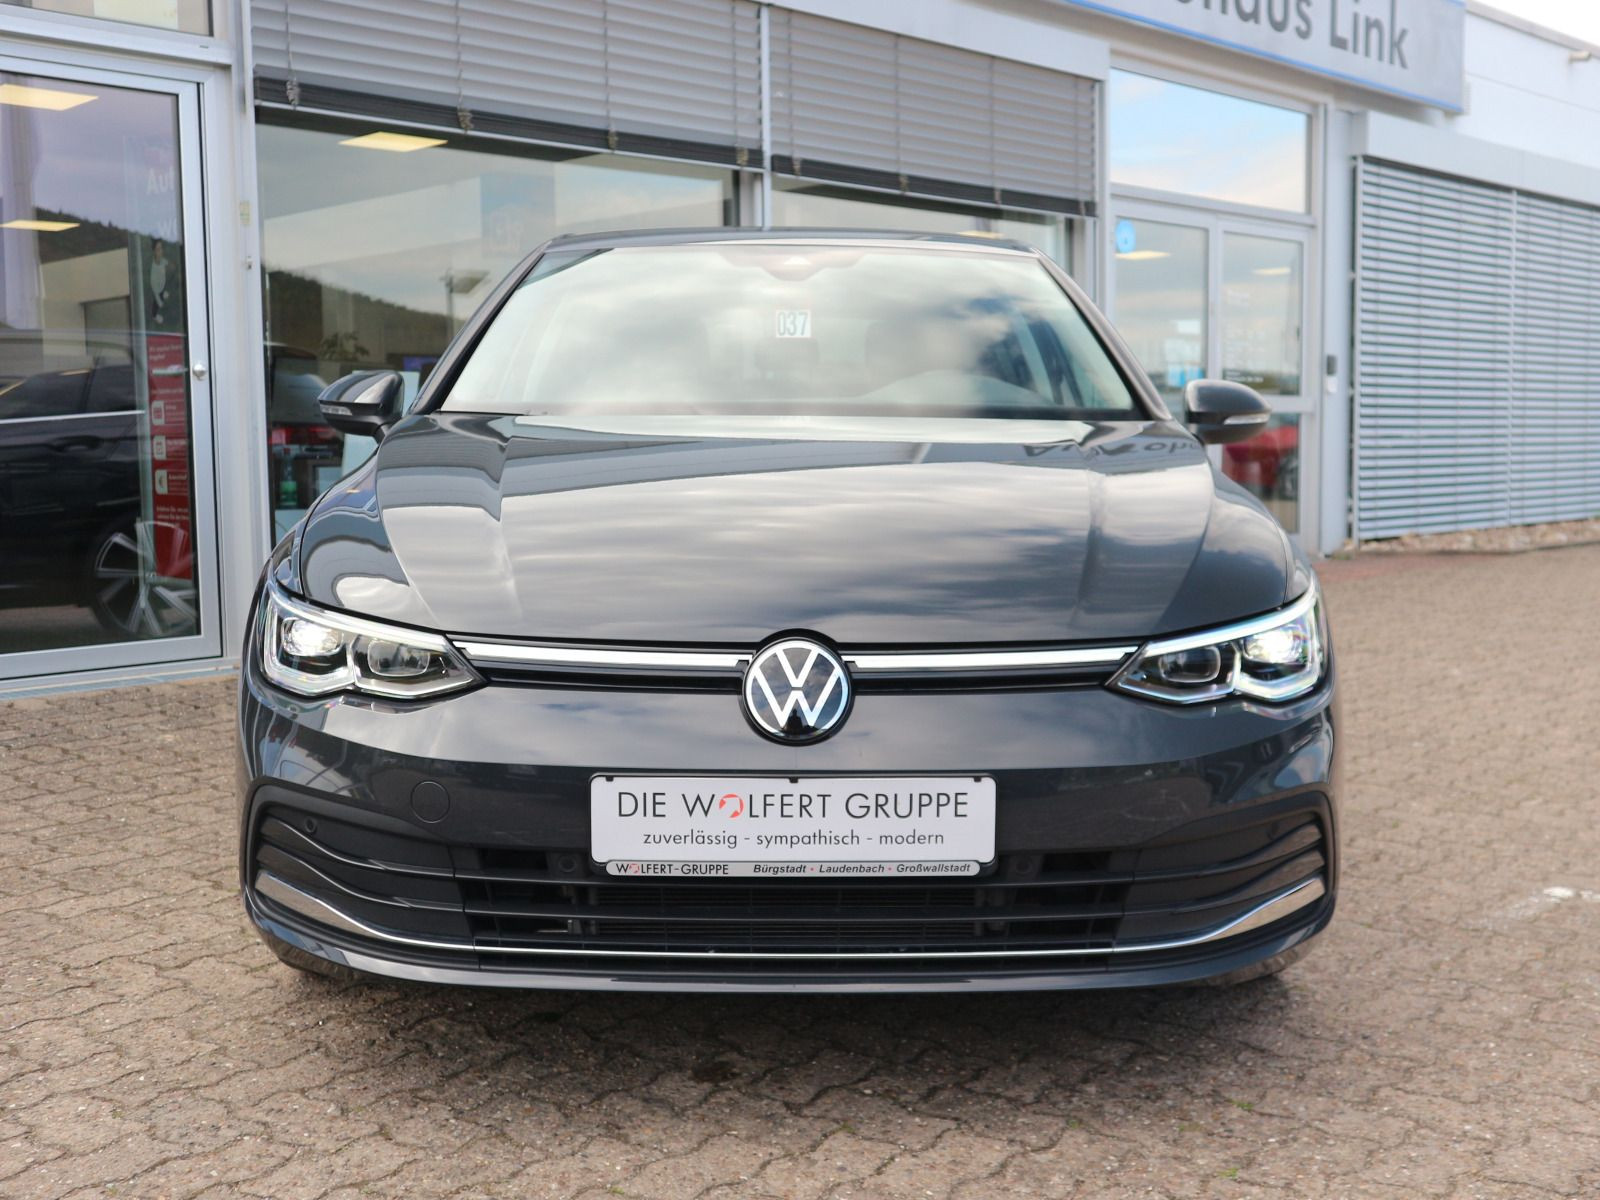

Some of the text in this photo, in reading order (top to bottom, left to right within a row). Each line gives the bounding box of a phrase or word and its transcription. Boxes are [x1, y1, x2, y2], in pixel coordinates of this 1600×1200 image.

[1329, 0, 1409, 69] Link
[777, 311, 809, 337] 037
[746, 641, 849, 735] VW
[618, 791, 968, 819] DIE WOLFERT GRUPPE
[643, 829, 738, 849] zuverlässig
[756, 829, 860, 849] sympathisch
[879, 829, 944, 845] modern
[615, 863, 970, 875] WOLFERT-GRUPPE Bürgstadt Laudenbach Großwallstadt
